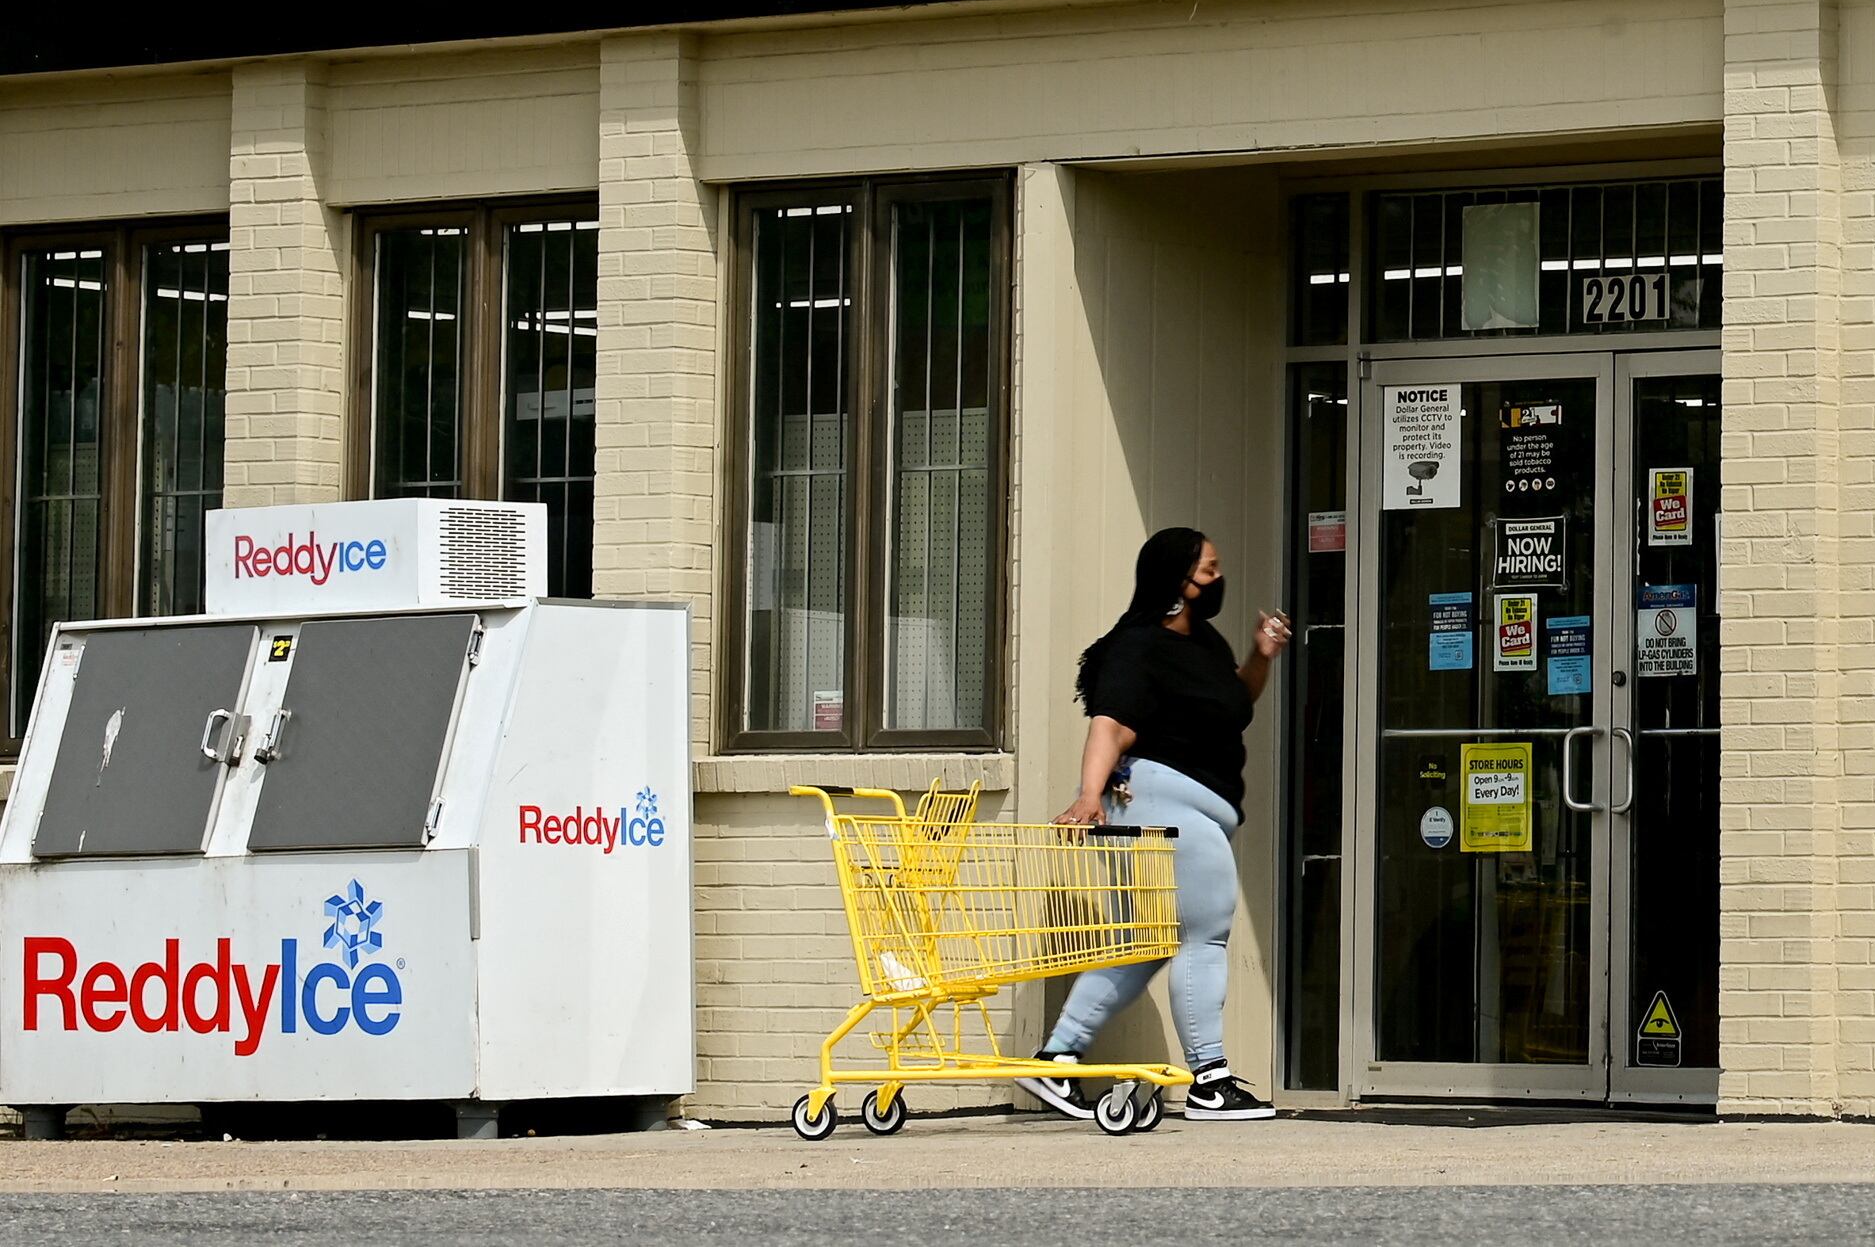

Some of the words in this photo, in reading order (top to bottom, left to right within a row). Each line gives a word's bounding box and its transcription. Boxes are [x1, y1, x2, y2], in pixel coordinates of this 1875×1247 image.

[1586, 275, 1665, 322] 2201
[1397, 390, 1447, 403] NOTICE
[1396, 405, 1418, 413] Dollar
[1420, 404, 1449, 413] General
[1393, 415, 1419, 423] utilizes
[1421, 414, 1442, 422] CCTV
[1400, 424, 1429, 432] monitor
[1431, 423, 1445, 431] and
[1403, 434, 1430, 442] protect
[1432, 432, 1441, 440] its
[1430, 441, 1452, 449] Video
[1660, 498, 1680, 510] We
[1656, 508, 1685, 521] Card
[1508, 537, 1552, 555] NOW
[1498, 555, 1561, 574] HIRING!
[1505, 624, 1525, 636] We
[1502, 633, 1530, 647] Card
[1646, 638, 1654, 648] DO
[1655, 638, 1667, 648] NOT
[1668, 637, 1686, 647] BRING
[1639, 649, 1660, 660] LP-GAS
[1661, 648, 1694, 659] CYLINDERS
[1639, 662, 1653, 671] INTO
[1654, 661, 1665, 671] THE
[1666, 660, 1693, 670] BUILDING
[1469, 759, 1494, 770] STORE
[1496, 759, 1523, 769] HOURS
[1474, 776, 1492, 785] Open
[1475, 788, 1499, 799] Every
[1500, 785, 1519, 797] Day!
